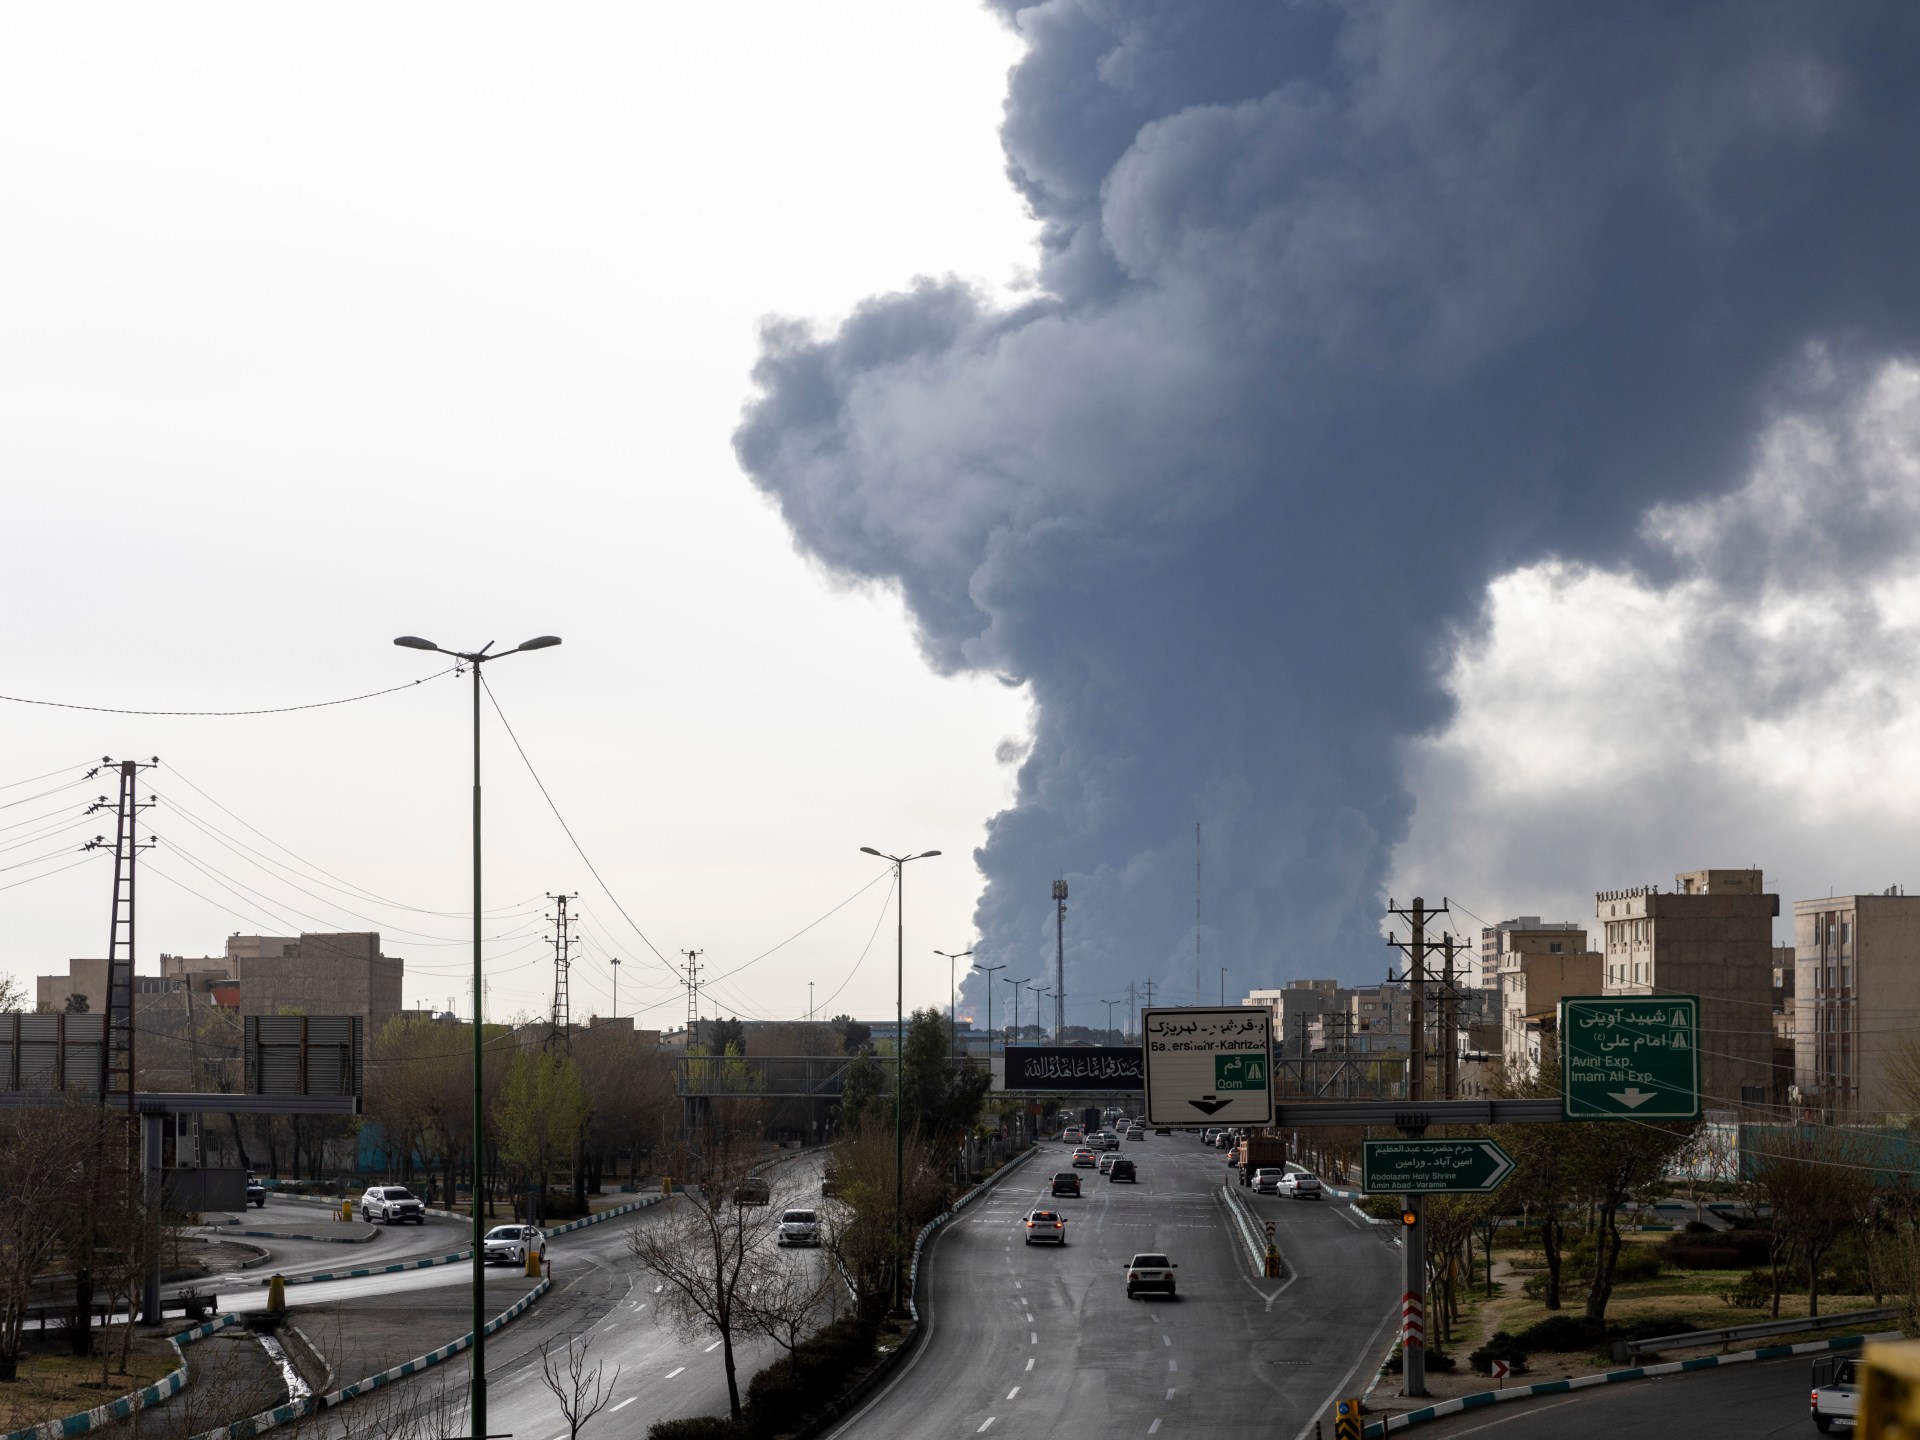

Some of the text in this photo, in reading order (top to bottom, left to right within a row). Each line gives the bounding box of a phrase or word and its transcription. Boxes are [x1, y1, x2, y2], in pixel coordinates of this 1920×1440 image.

[1580, 1008, 1666, 1028] شهید آوینی
[1634, 1033, 1666, 1053] امام
[1224, 1056, 1242, 1075] قم
[1571, 1055, 1633, 1069] Avini Exp.
[1571, 1070, 1605, 1082] Imam
[1609, 1070, 1624, 1082] Ali
[1217, 1078, 1243, 1090] Qom
[1422, 1144, 1454, 1155] حضرت
[1455, 1145, 1473, 1156] حرم
[1395, 1157, 1426, 1169] ورامین
[1434, 1156, 1451, 1168] آباد
[1452, 1157, 1473, 1168] امین
[1371, 1172, 1457, 1181] Abdolazim Holy Shrine
